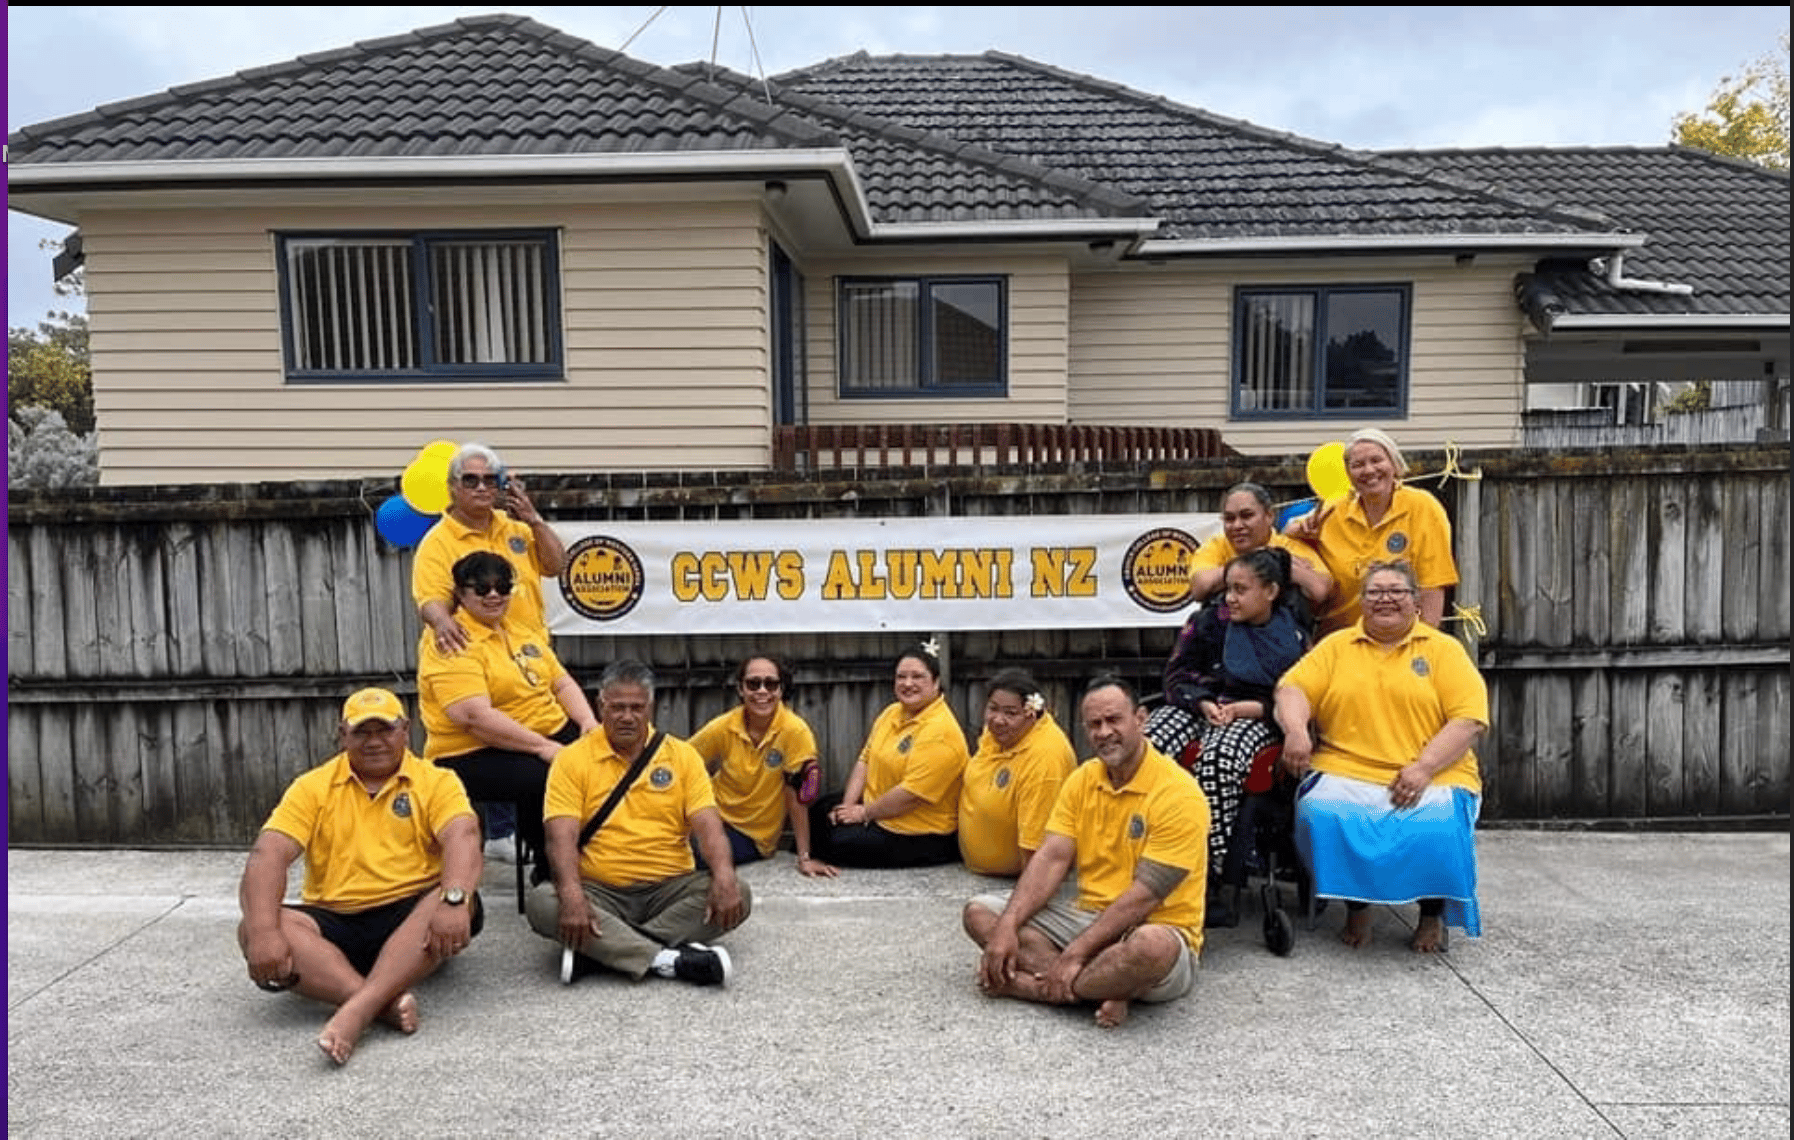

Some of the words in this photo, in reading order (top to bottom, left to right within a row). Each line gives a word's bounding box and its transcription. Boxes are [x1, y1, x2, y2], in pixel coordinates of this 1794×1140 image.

[671, 549, 805, 602] CCWS
[821, 548, 1013, 600] ALUMNI
[1031, 546, 1098, 598] NZ
[1136, 565, 1189, 576] ALUMN
[574, 572, 631, 584] ALUMNI
